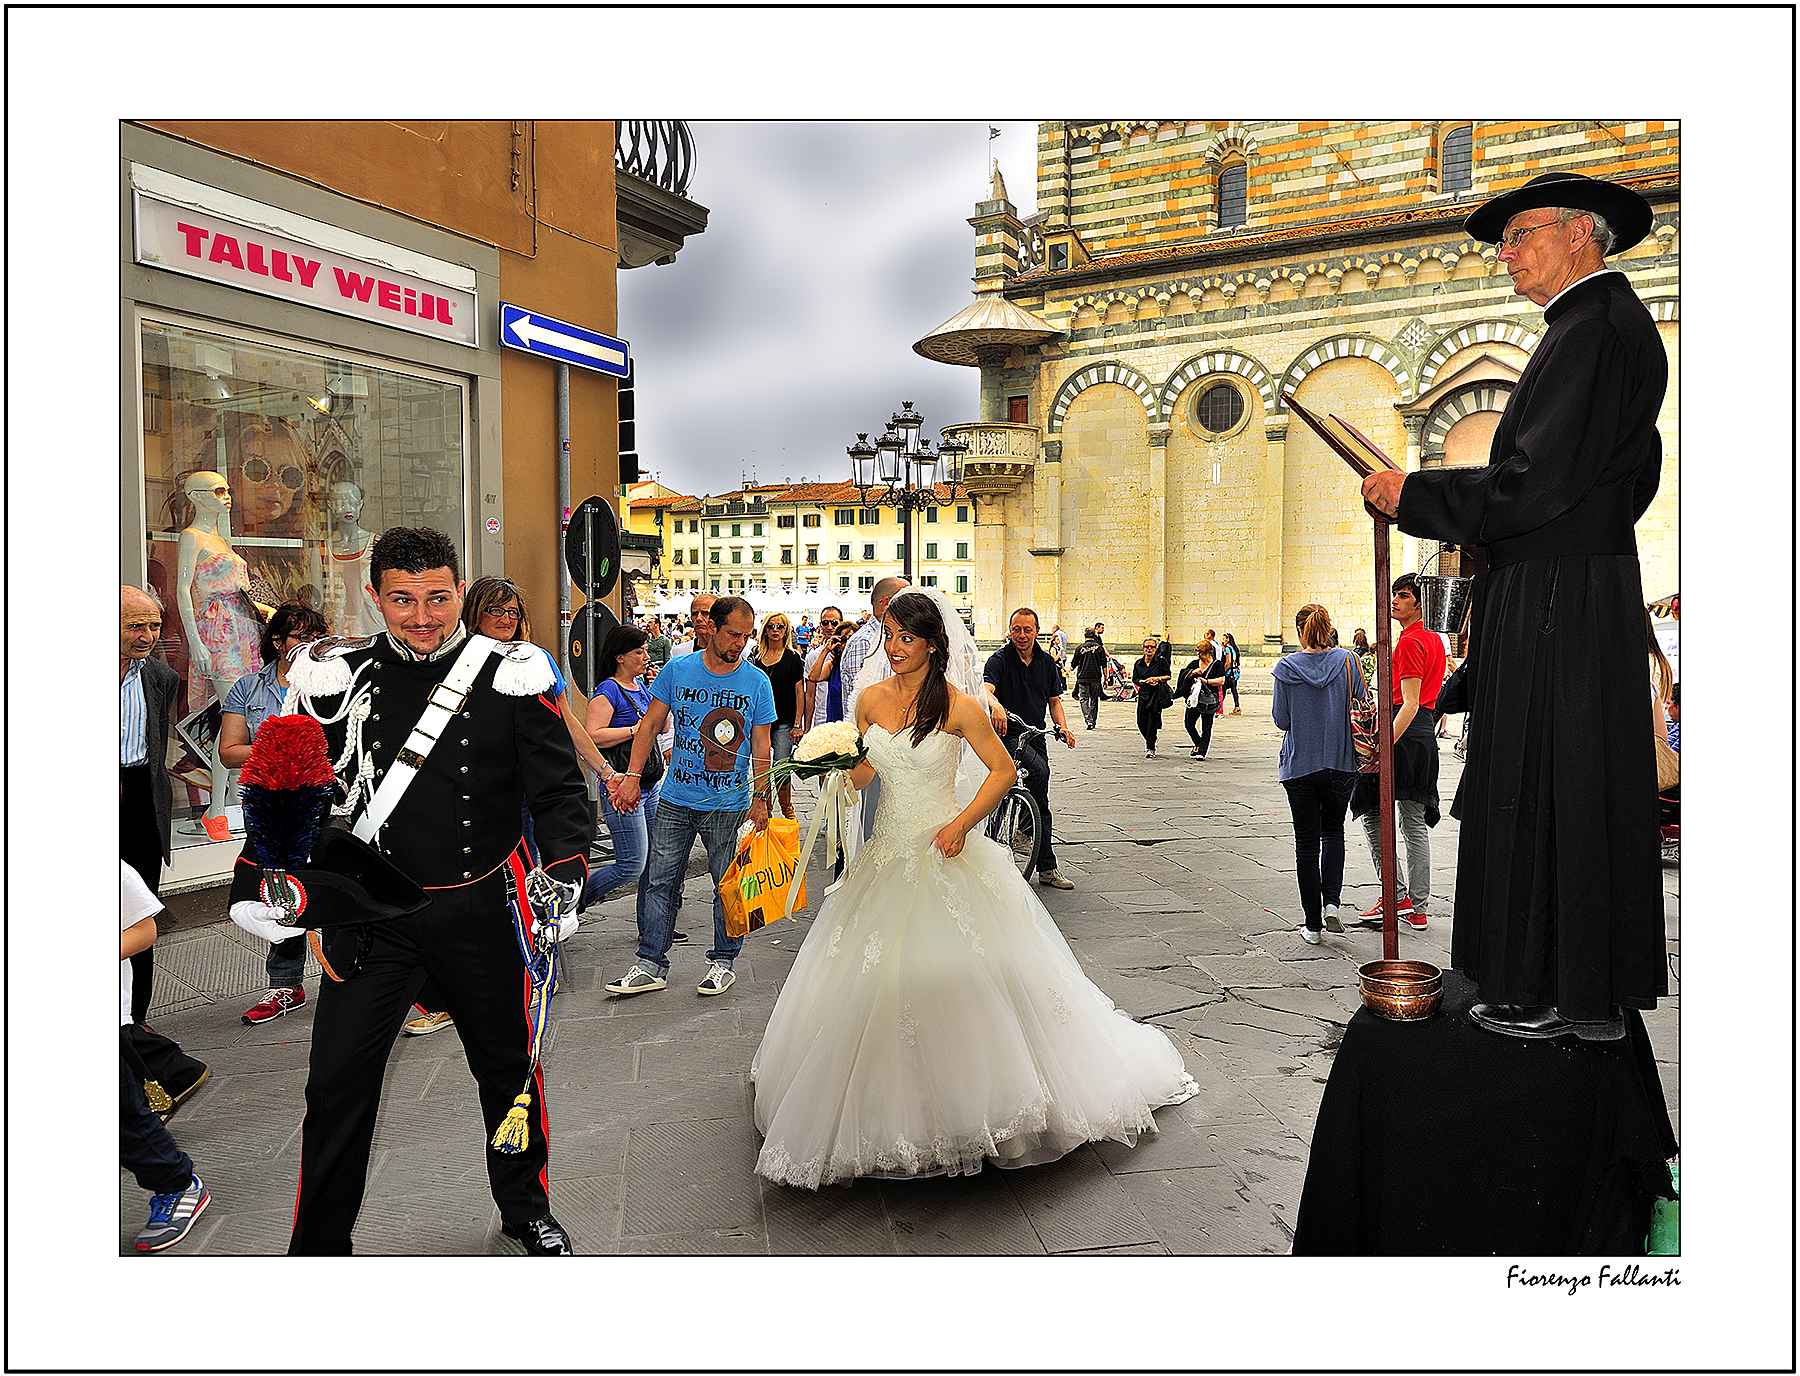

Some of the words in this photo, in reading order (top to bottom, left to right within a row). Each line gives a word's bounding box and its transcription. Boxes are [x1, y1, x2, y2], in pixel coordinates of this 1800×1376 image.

[177, 222, 322, 289] TALLY
[675, 685, 709, 704] WHO
[676, 705, 700, 731] SEX
